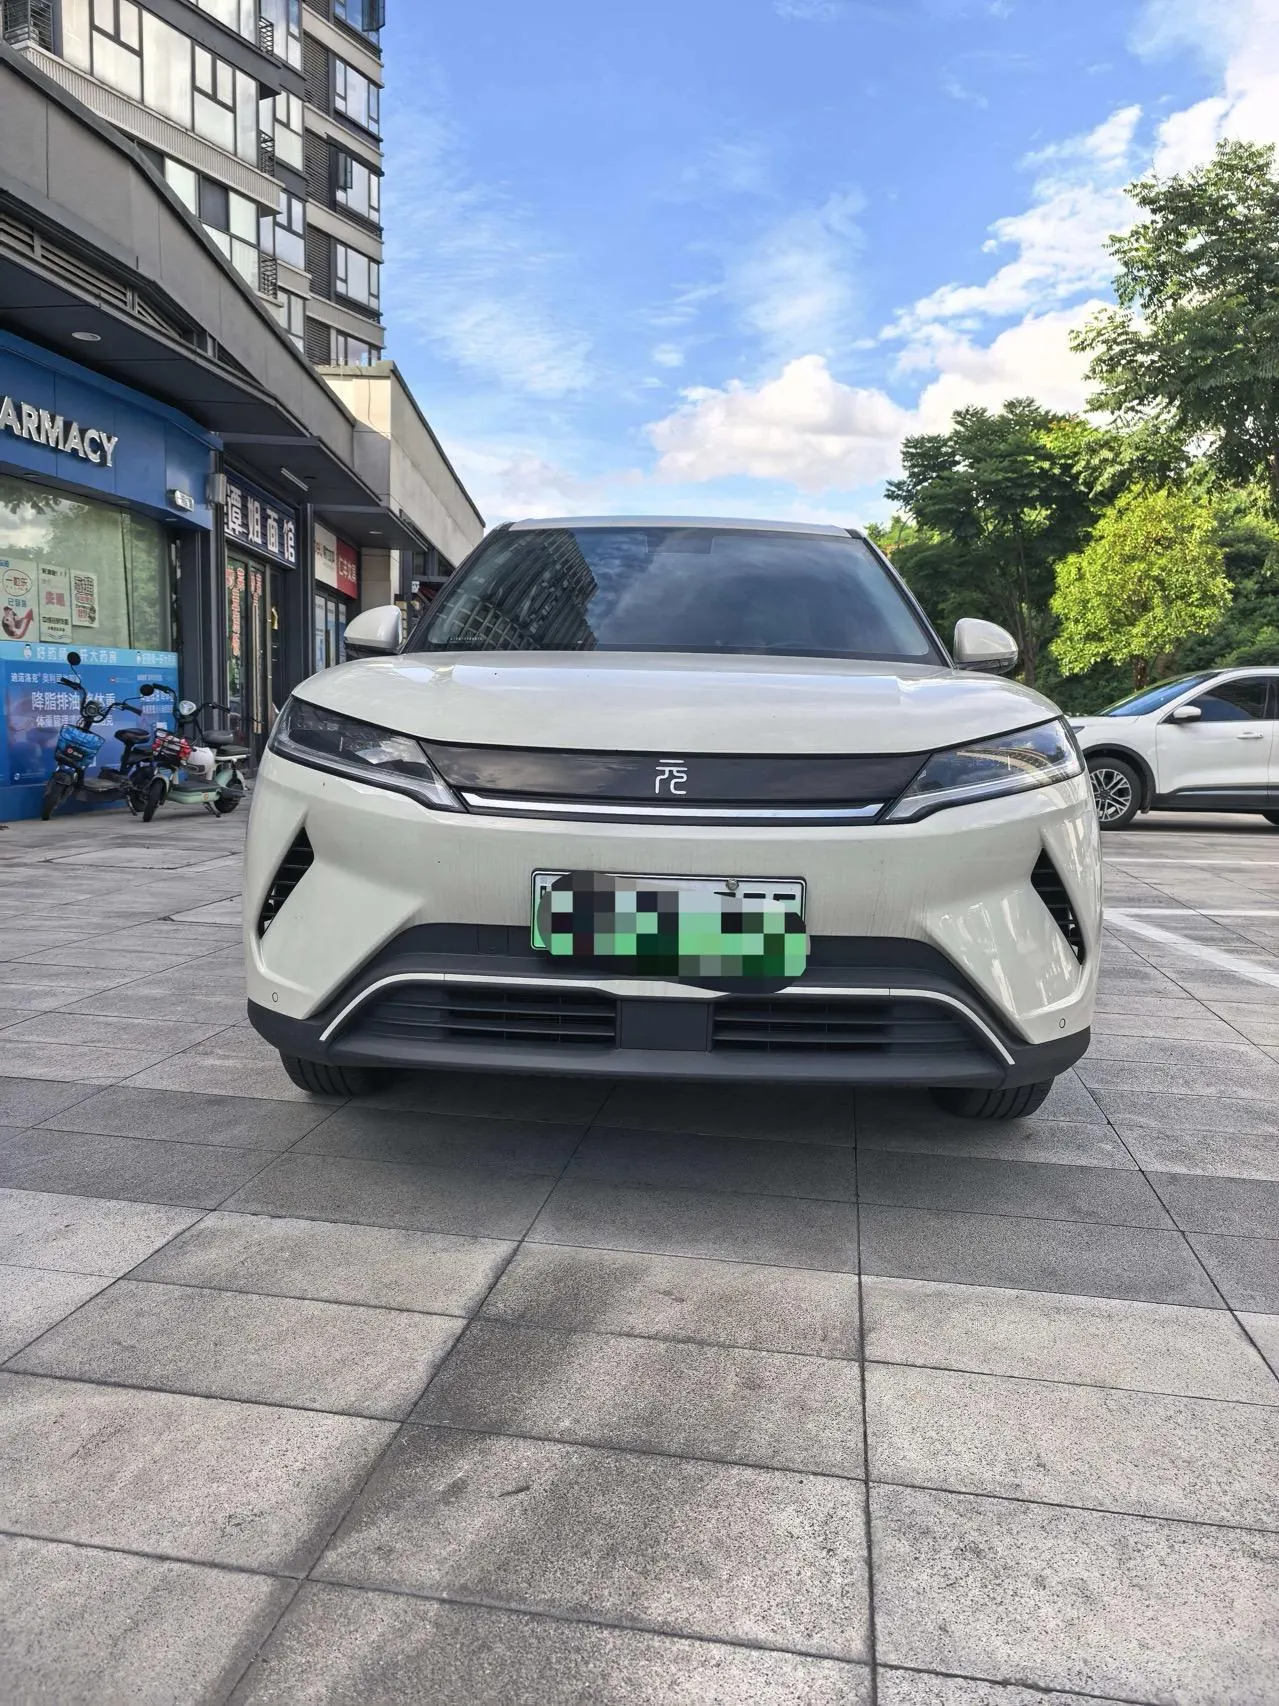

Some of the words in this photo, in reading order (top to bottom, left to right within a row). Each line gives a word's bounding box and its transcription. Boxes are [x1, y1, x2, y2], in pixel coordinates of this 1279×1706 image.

[0, 396, 118, 466] ARMACY
[224, 484, 296, 562] 谭姐面馆
[654, 759, 688, 795] 元
